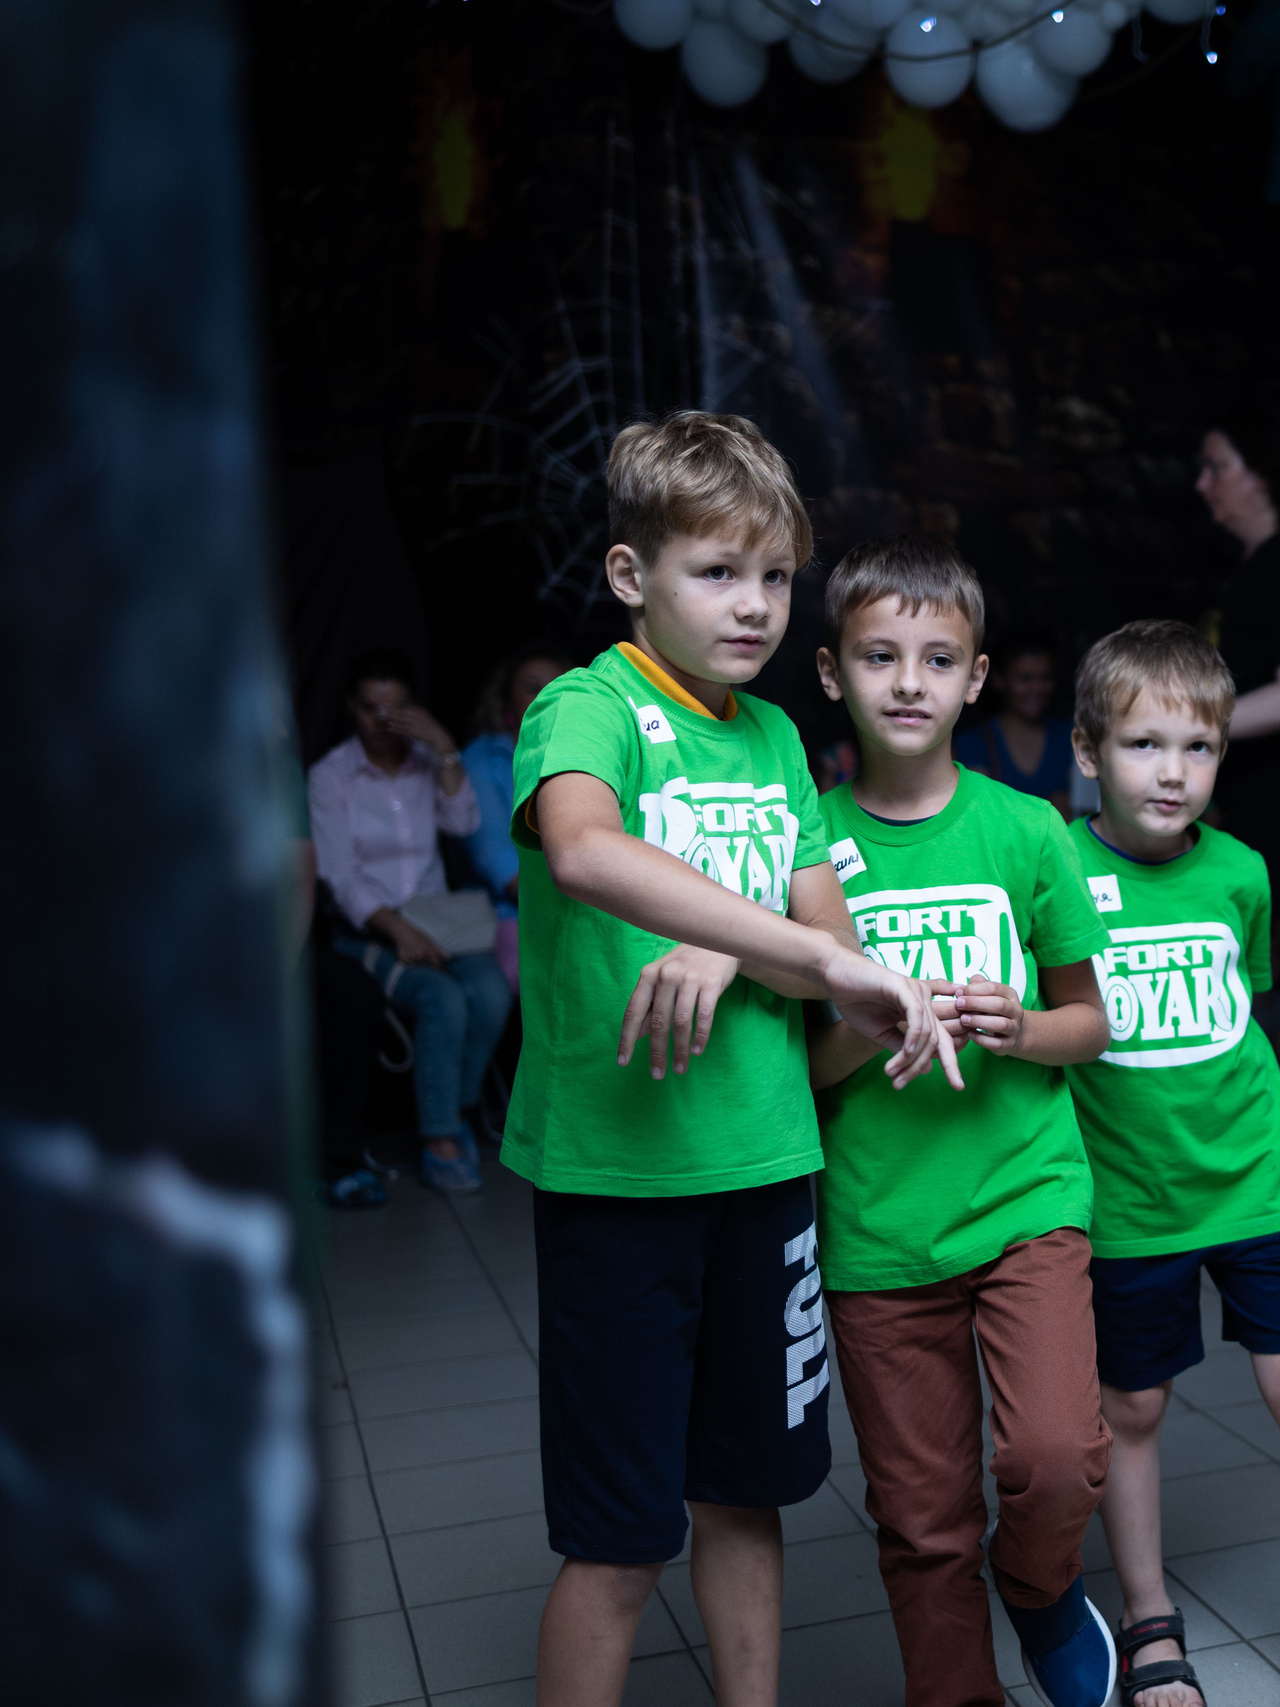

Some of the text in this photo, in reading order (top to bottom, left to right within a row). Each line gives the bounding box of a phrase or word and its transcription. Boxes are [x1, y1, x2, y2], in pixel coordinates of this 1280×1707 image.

[855, 905, 968, 943] FORT
[1103, 940, 1207, 973] FORT
[1092, 941, 1251, 1042] OYARD
